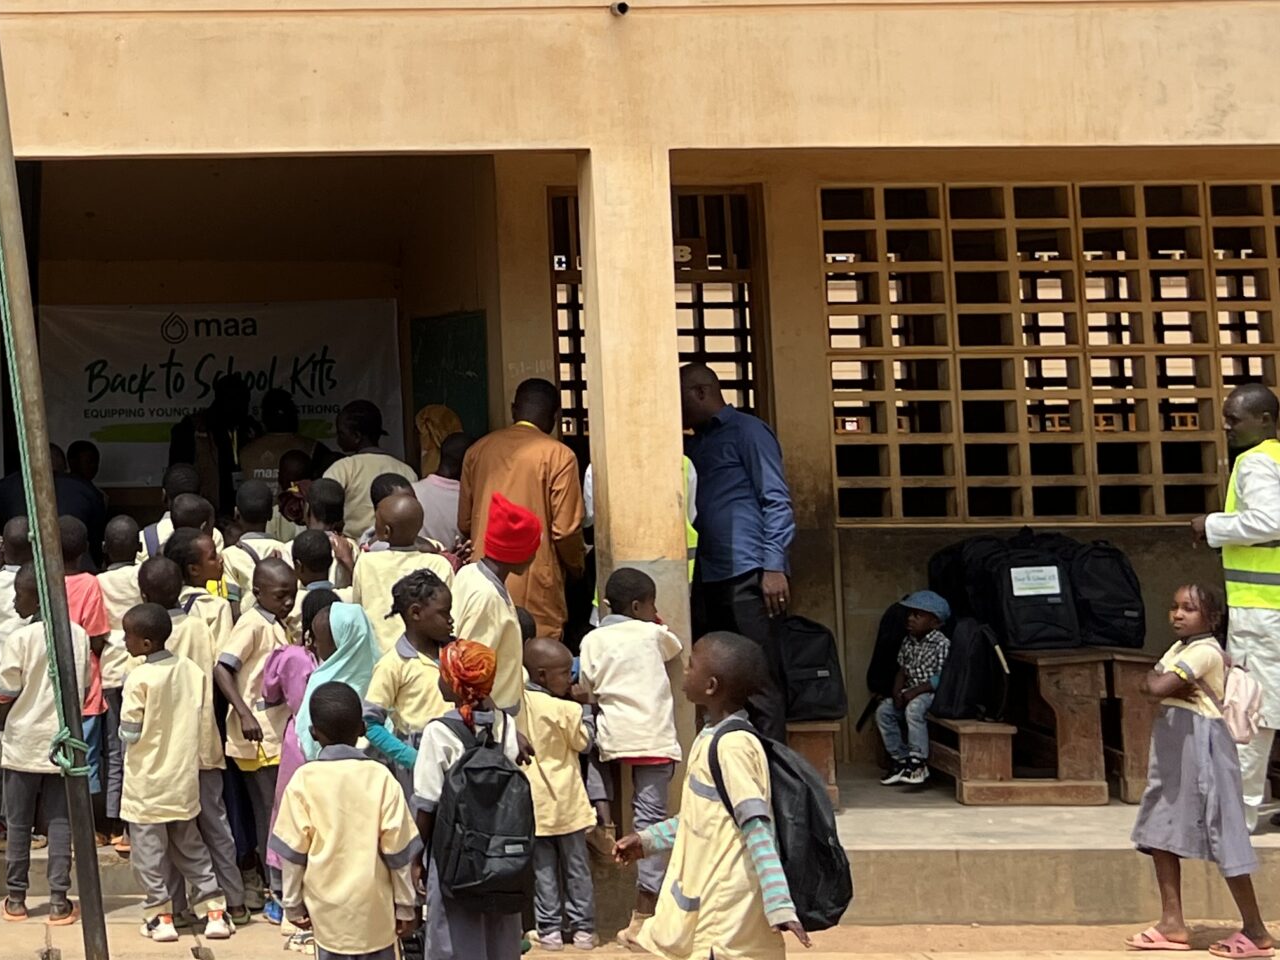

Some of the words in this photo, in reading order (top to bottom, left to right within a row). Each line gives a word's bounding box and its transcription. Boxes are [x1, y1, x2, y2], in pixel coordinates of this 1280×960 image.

[673, 245, 692, 262] B
[194, 317, 258, 337] maa
[84, 359, 157, 403] Back
[158, 348, 185, 400] to
[84, 408, 145, 419] EQUIPPING
[148, 407, 190, 417] YOUNG
